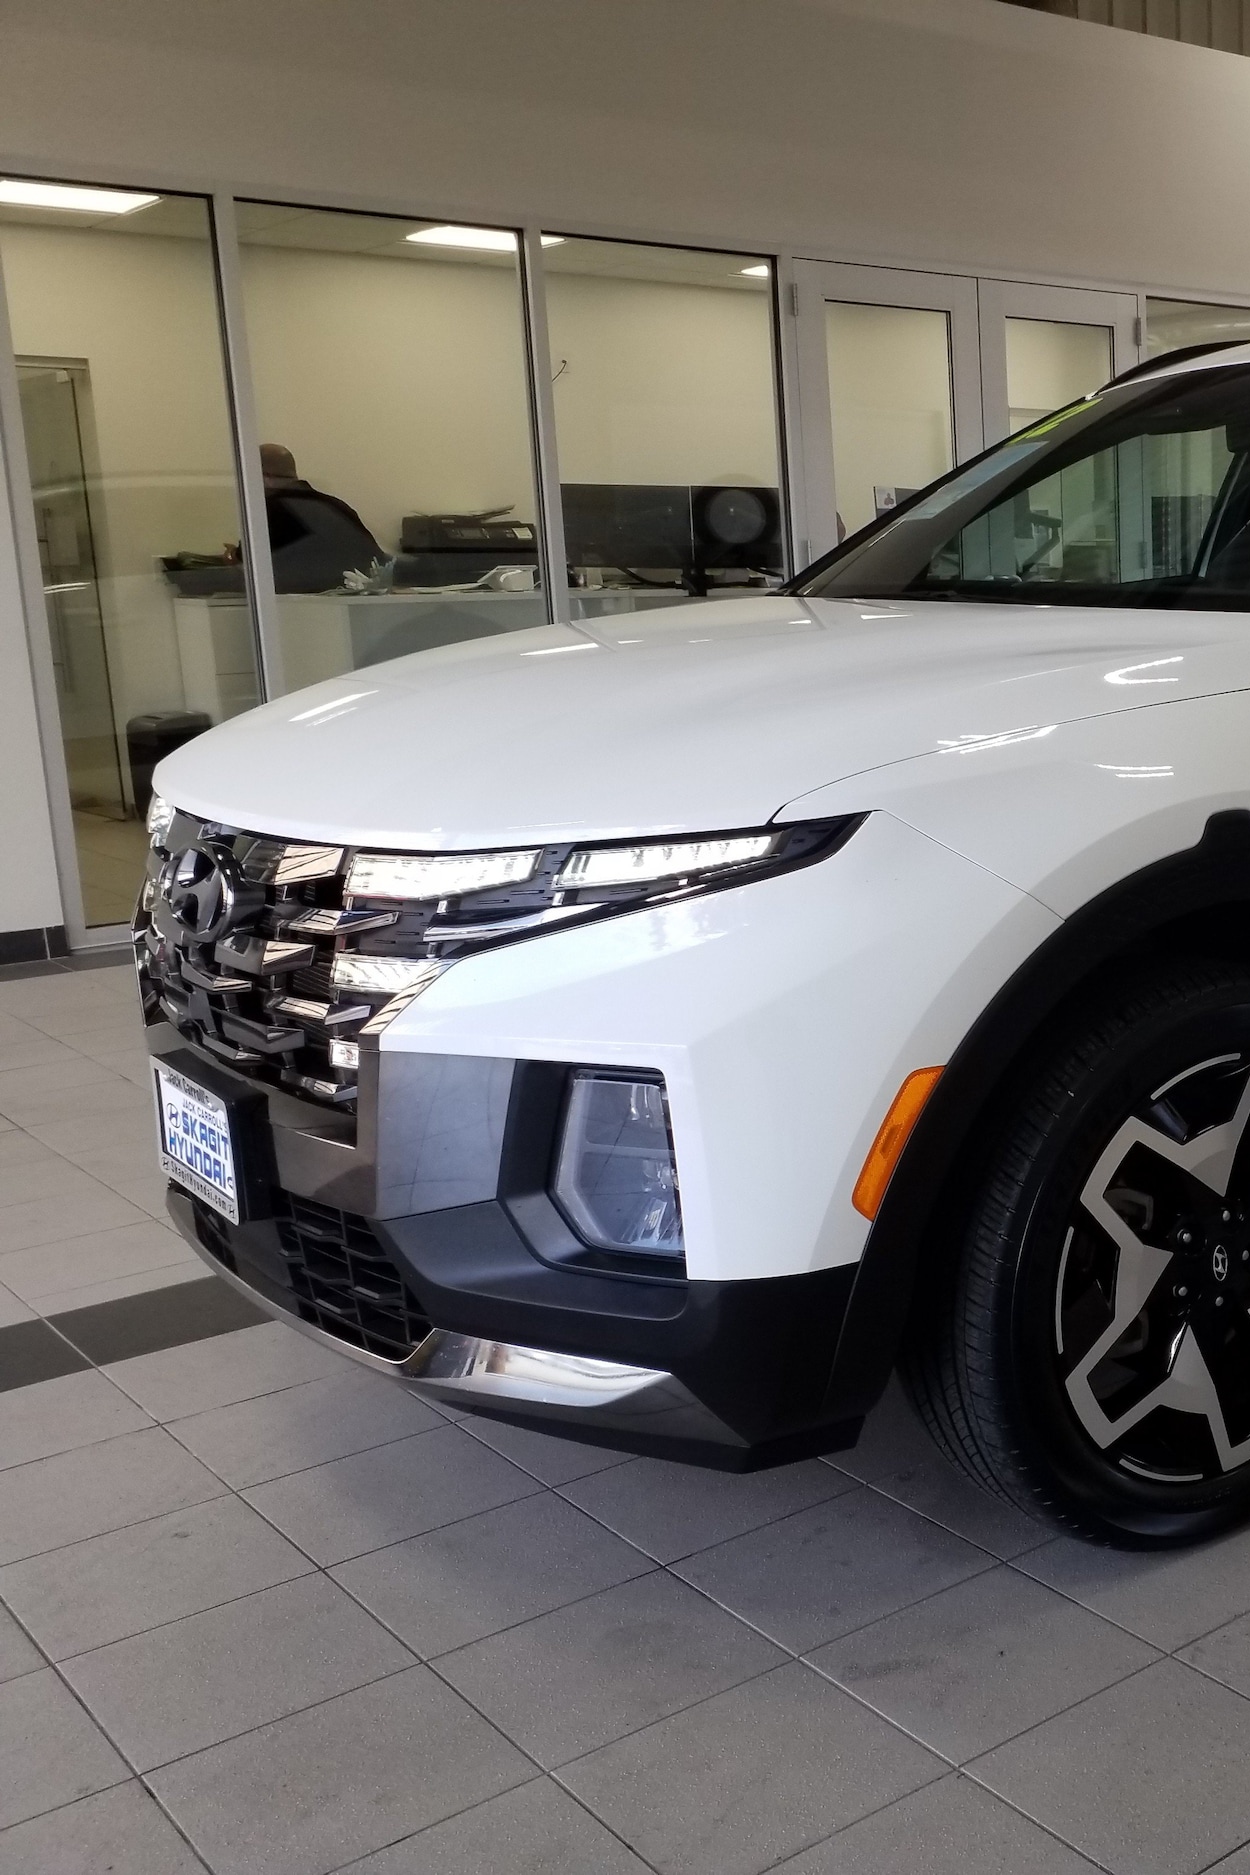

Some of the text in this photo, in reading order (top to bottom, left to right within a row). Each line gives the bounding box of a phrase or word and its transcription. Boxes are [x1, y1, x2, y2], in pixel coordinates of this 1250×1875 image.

[168, 1068, 210, 1103] Jack Carroll's
[182, 1099, 198, 1115] JACK
[181, 1112, 229, 1161] SKAGIT
[169, 1127, 227, 1190] HYUNDAI
